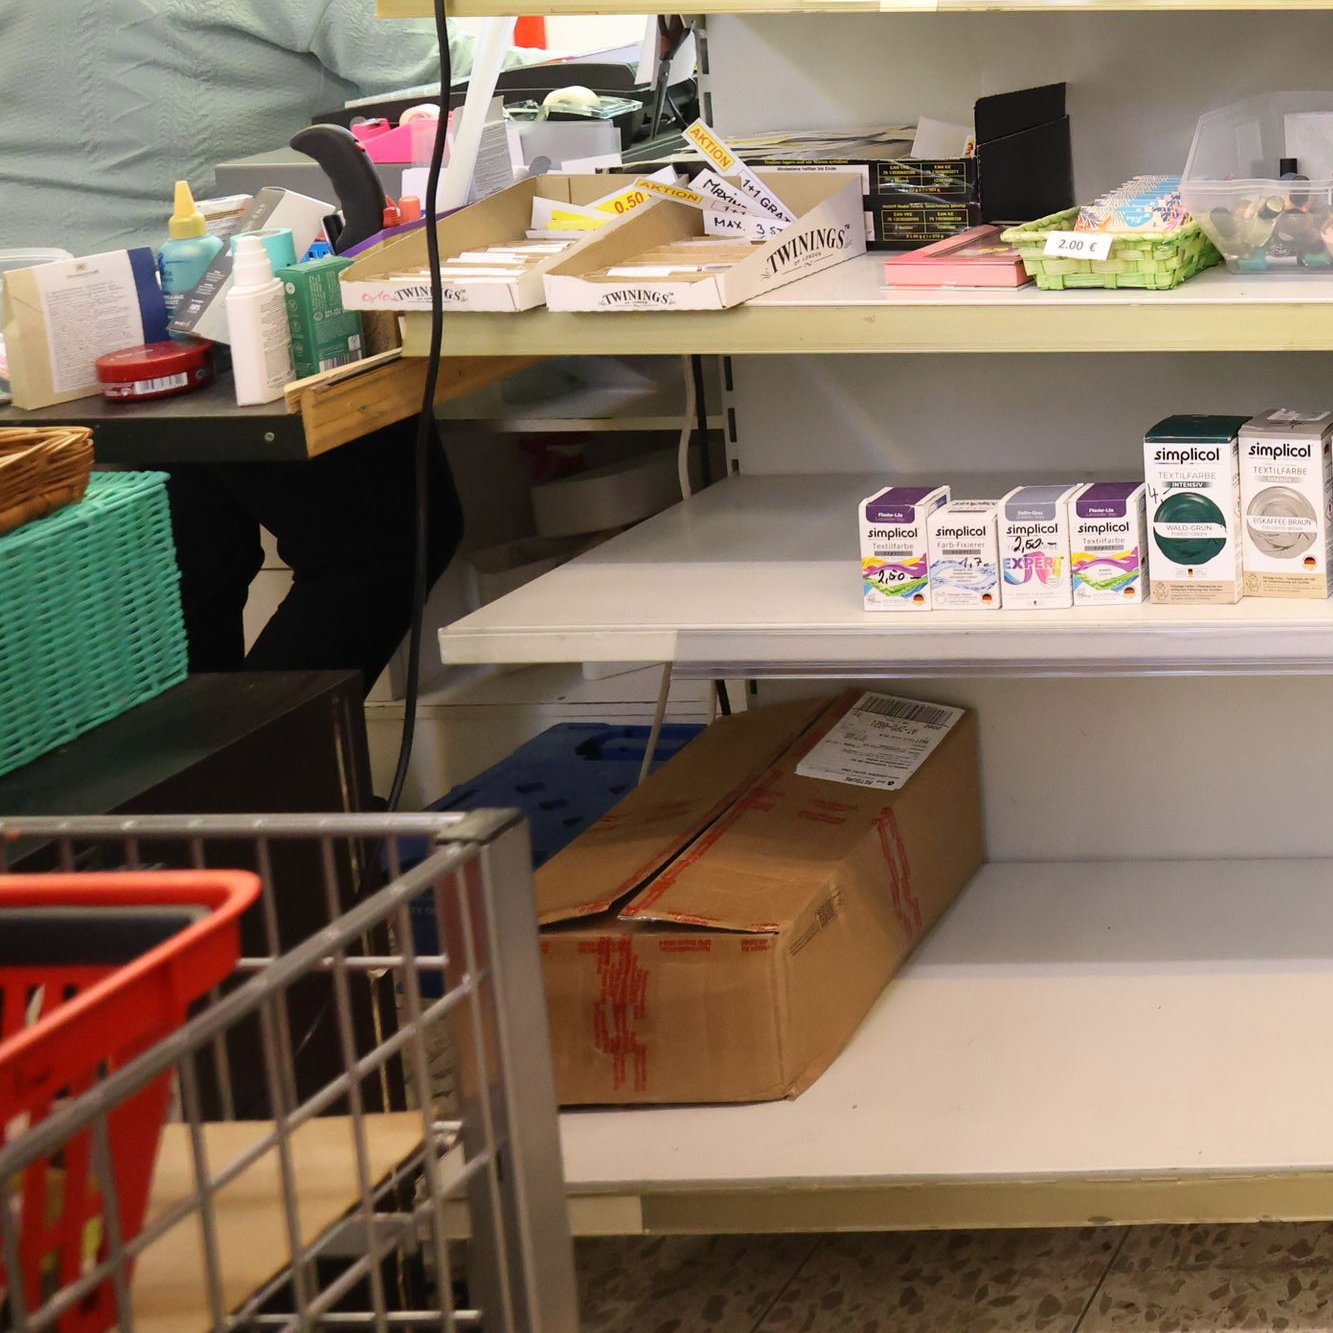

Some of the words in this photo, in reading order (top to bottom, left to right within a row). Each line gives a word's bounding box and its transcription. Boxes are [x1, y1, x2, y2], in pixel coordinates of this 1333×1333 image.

[689, 126, 731, 168] AKTION
[640, 180, 699, 203] AKTION
[614, 190, 644, 215] 0.50
[766, 228, 845, 274] TWININGS
[1058, 239, 1084, 251] 2.00
[1089, 242, 1097, 252] €
[602, 290, 671, 305] TWININGS
[1154, 448, 1220, 464] simplicol
[1249, 443, 1311, 460] simplicol
[1254, 467, 1308, 475] TEXTILFARBE
[1166, 524, 1212, 532] WALD-GRÜN
[1253, 517, 1312, 526] EISKAFFEE-BRAUN
[868, 528, 918, 541] simplicol
[936, 526, 986, 539] simplicol
[1007, 523, 1058, 536] simplicol
[1078, 522, 1129, 535] simplicol
